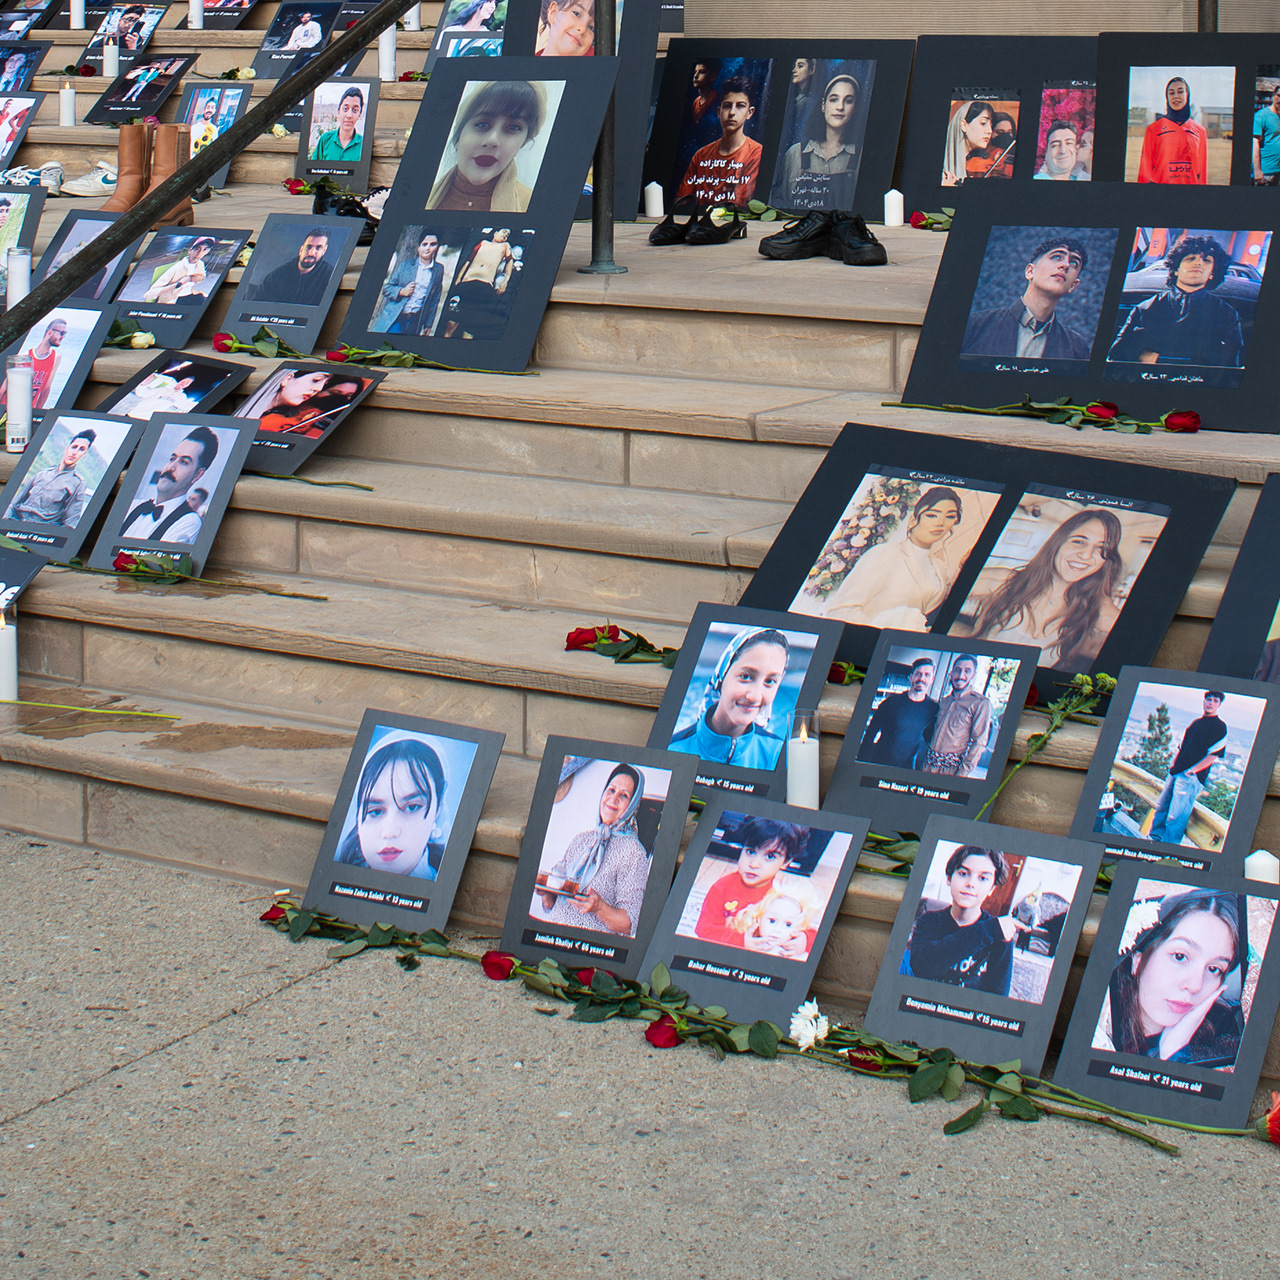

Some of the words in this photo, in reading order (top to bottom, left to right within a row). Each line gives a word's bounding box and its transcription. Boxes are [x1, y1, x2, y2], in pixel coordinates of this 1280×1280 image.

[687, 175, 706, 185] تهران
[714, 193, 726, 202] دی
[730, 783, 745, 792] years
[744, 784, 755, 793] old
[923, 790, 940, 798] years
[939, 791, 950, 800] old
[1193, 861, 1205, 870] old
[398, 897, 413, 907] years
[413, 900, 423, 910] old
[590, 946, 605, 955] years
[605, 947, 615, 958] old
[743, 973, 760, 984] years
[760, 976, 772, 986] old
[936, 1004, 975, 1021] Mohammadi
[982, 1014, 990, 1025] 15
[990, 1018, 1008, 1029] years
[1008, 1022, 1020, 1032] old
[1109, 1065, 1125, 1076] Asal
[1161, 1075, 1170, 1085] 21
[1170, 1079, 1190, 1090] years
[1190, 1082, 1203, 1093] old
